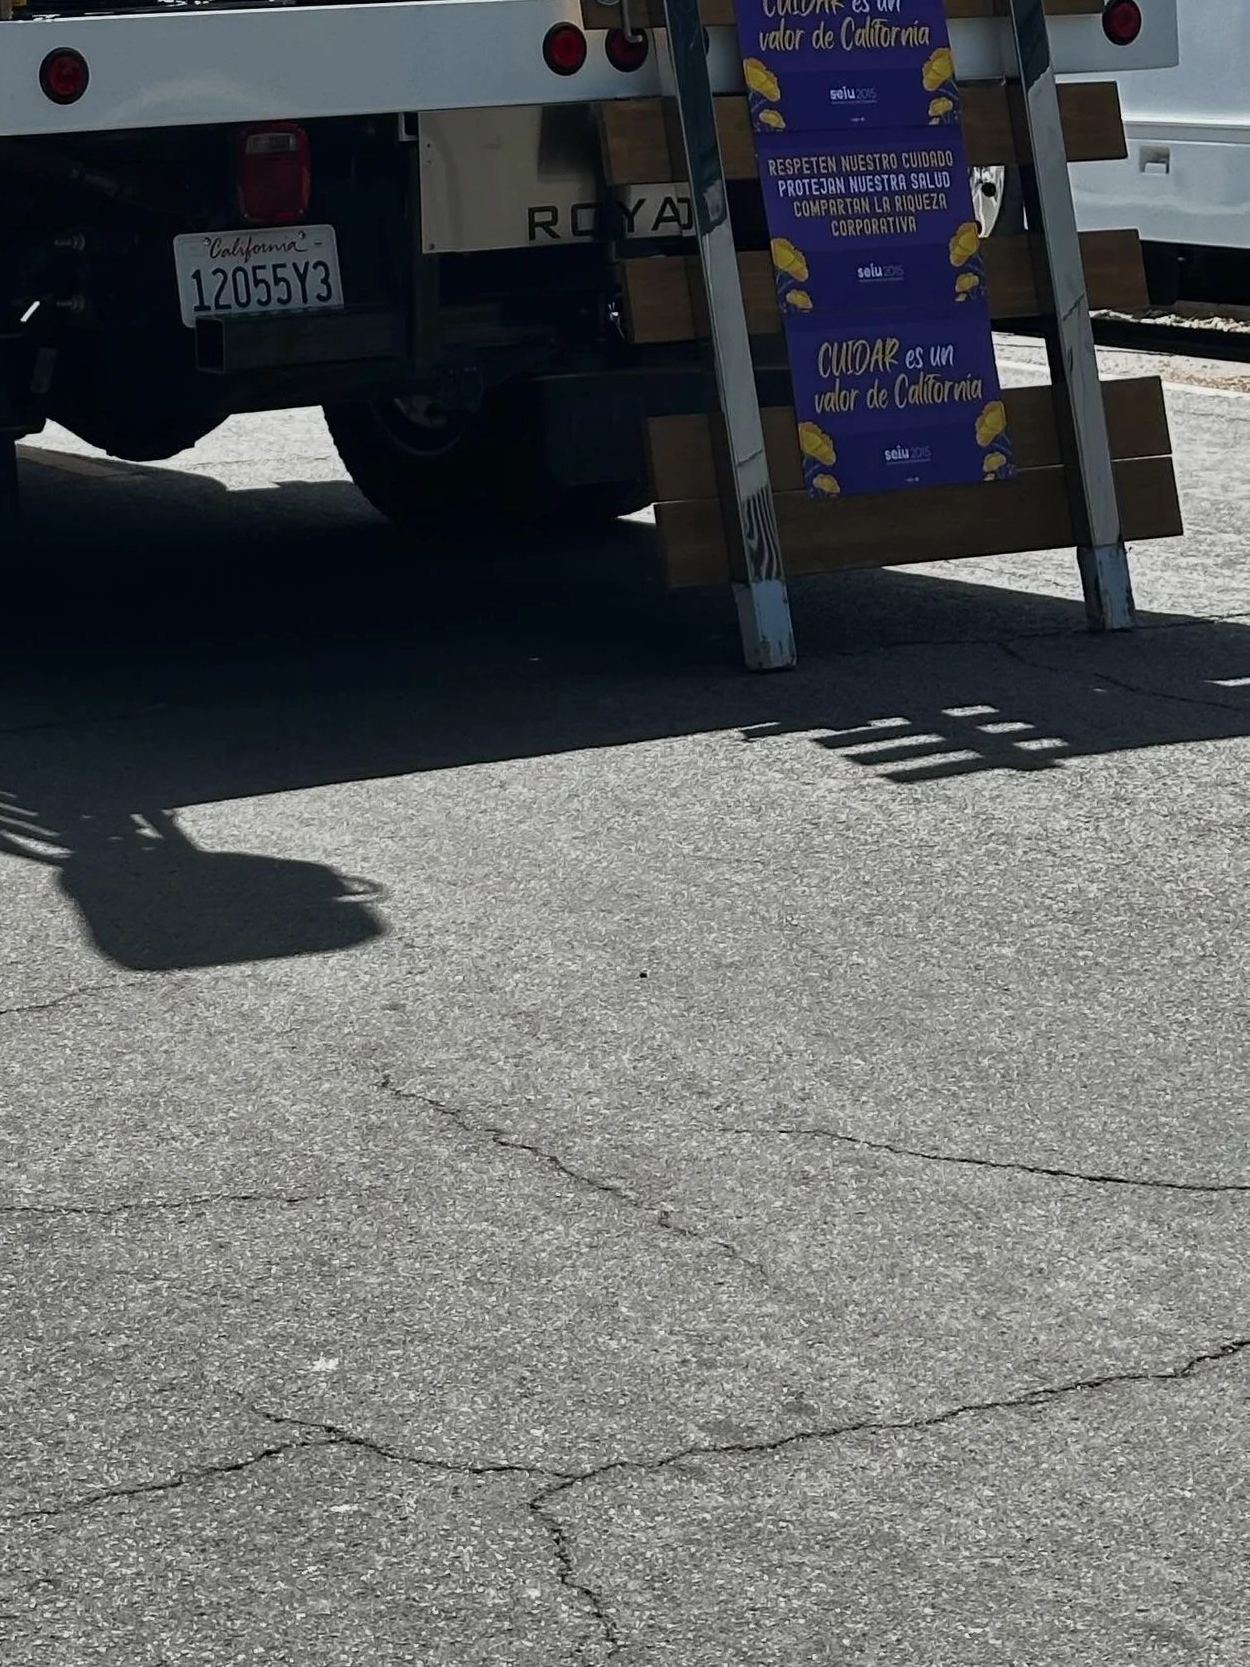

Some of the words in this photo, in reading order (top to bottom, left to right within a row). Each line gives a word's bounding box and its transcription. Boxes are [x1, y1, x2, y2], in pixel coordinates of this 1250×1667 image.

[759, 18, 804, 51] valor
[812, 21, 834, 50] de
[840, 16, 930, 51] California
[830, 86, 855, 100] seiu
[856, 87, 877, 99] 2015
[768, 155, 836, 176] RESPETEN
[840, 152, 898, 172] NUESTRO
[902, 150, 954, 169] CUIDADO
[778, 176, 845, 198] PROTEJAN
[849, 173, 907, 194] NUESTRA
[911, 171, 951, 190] SALUD
[794, 196, 870, 218] COMPARTAN
[874, 195, 891, 213] LA
[895, 192, 947, 213] RIQUEZA
[831, 215, 918, 237] CORPORATIVA
[209, 236, 308, 262] California
[857, 263, 883, 278] seiu
[191, 260, 333, 312] 12055Y3
[818, 338, 900, 378] CUIDAR
[905, 346, 923, 369] es
[930, 344, 954, 366] un
[814, 379, 860, 414] valor
[866, 379, 889, 409] de
[894, 372, 982, 409] California
[885, 445, 910, 461] seiu
